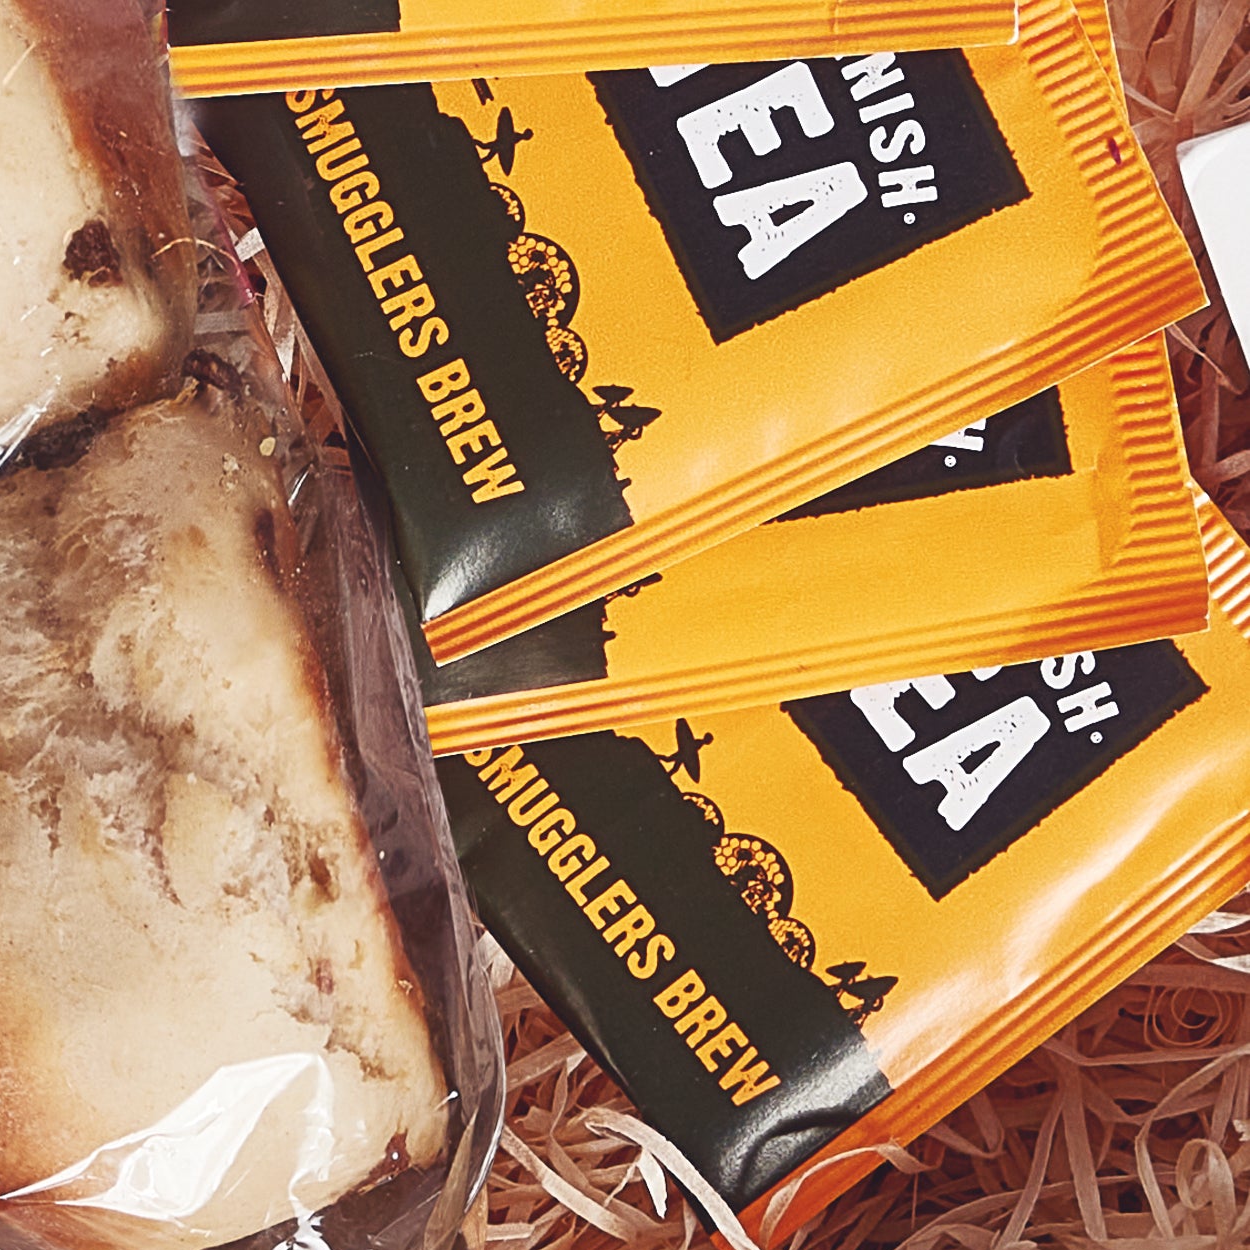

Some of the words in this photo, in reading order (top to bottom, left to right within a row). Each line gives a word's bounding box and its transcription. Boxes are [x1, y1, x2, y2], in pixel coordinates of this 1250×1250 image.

[649, 62, 869, 280] EA
[835, 53, 938, 208] NISH
[417, 357, 525, 504] BREW
[653, 969, 781, 1106] BREW
